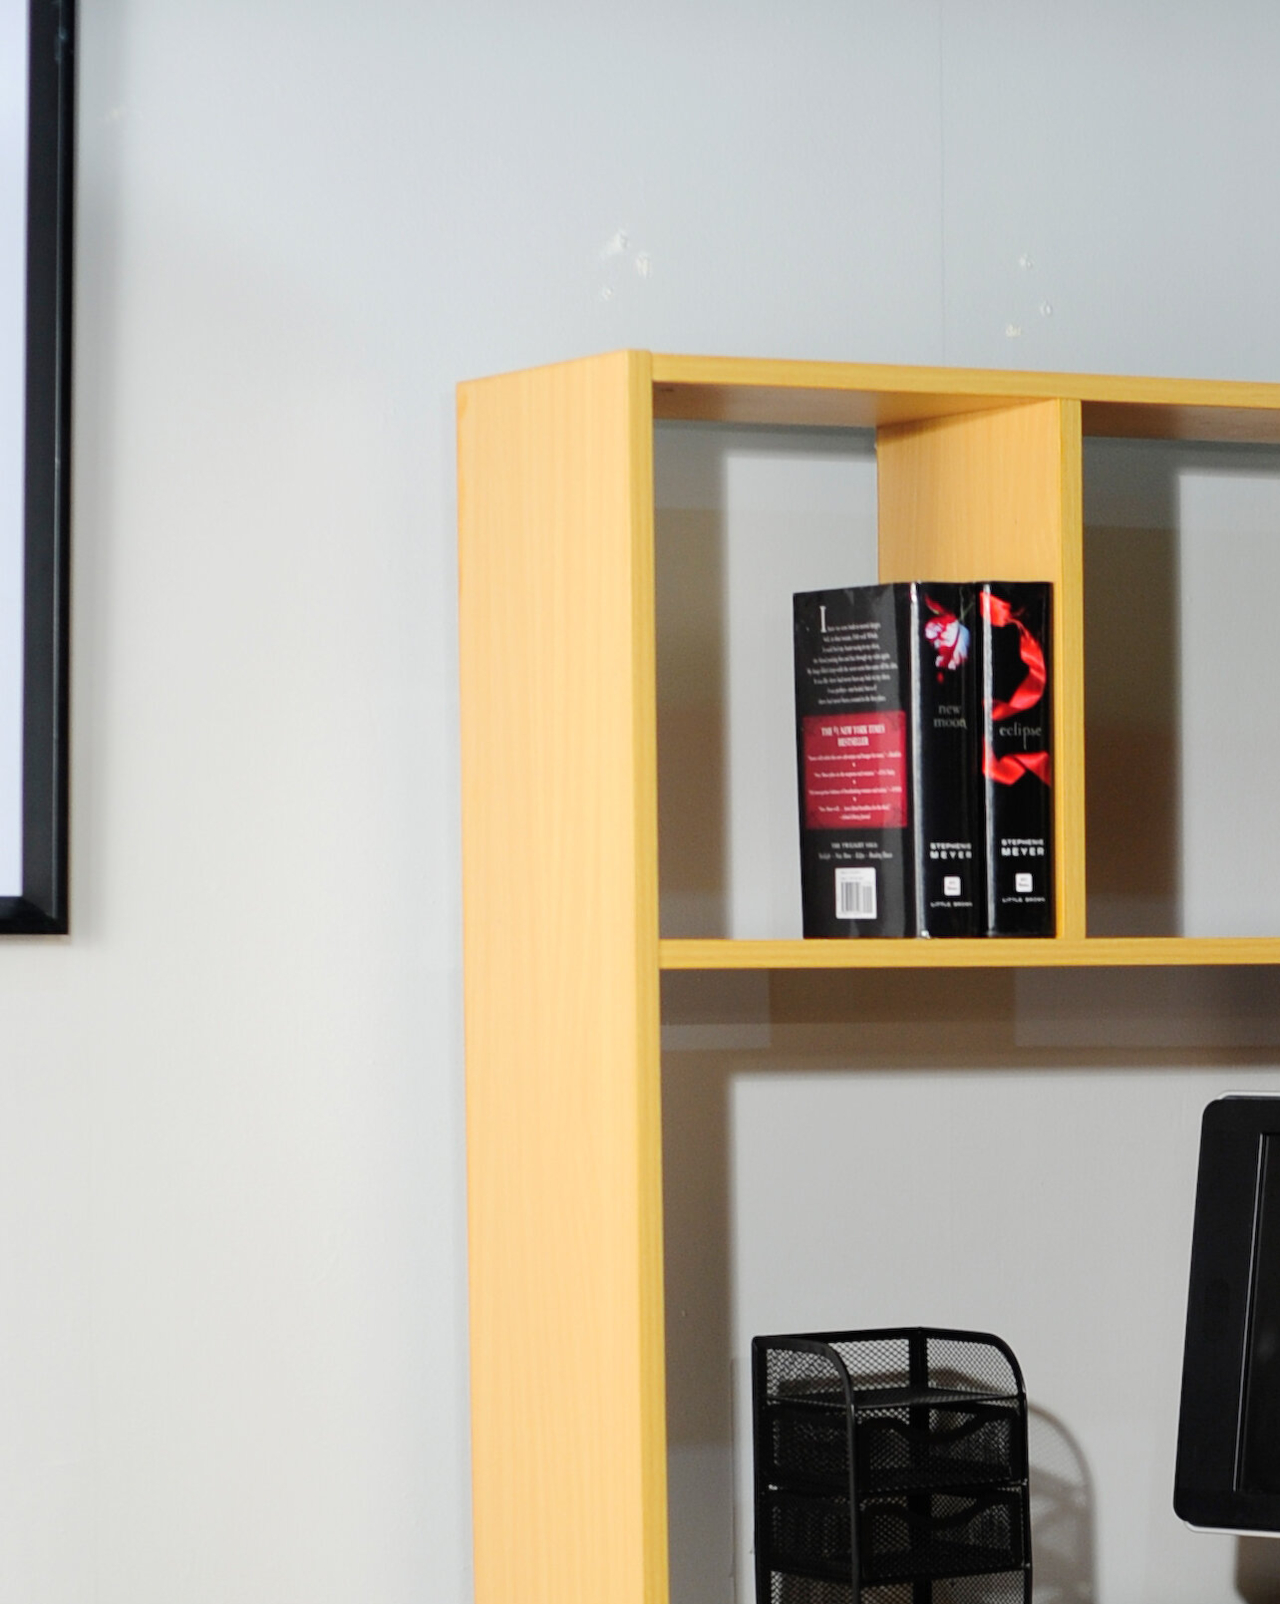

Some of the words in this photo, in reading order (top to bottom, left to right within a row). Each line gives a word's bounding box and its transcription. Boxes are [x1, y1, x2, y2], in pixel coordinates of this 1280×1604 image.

[938, 704, 960, 715] new
[933, 718, 968, 729] moon
[999, 722, 1042, 750] eclipse
[930, 850, 972, 859] MEYER
[1001, 847, 1045, 856] MEYER
